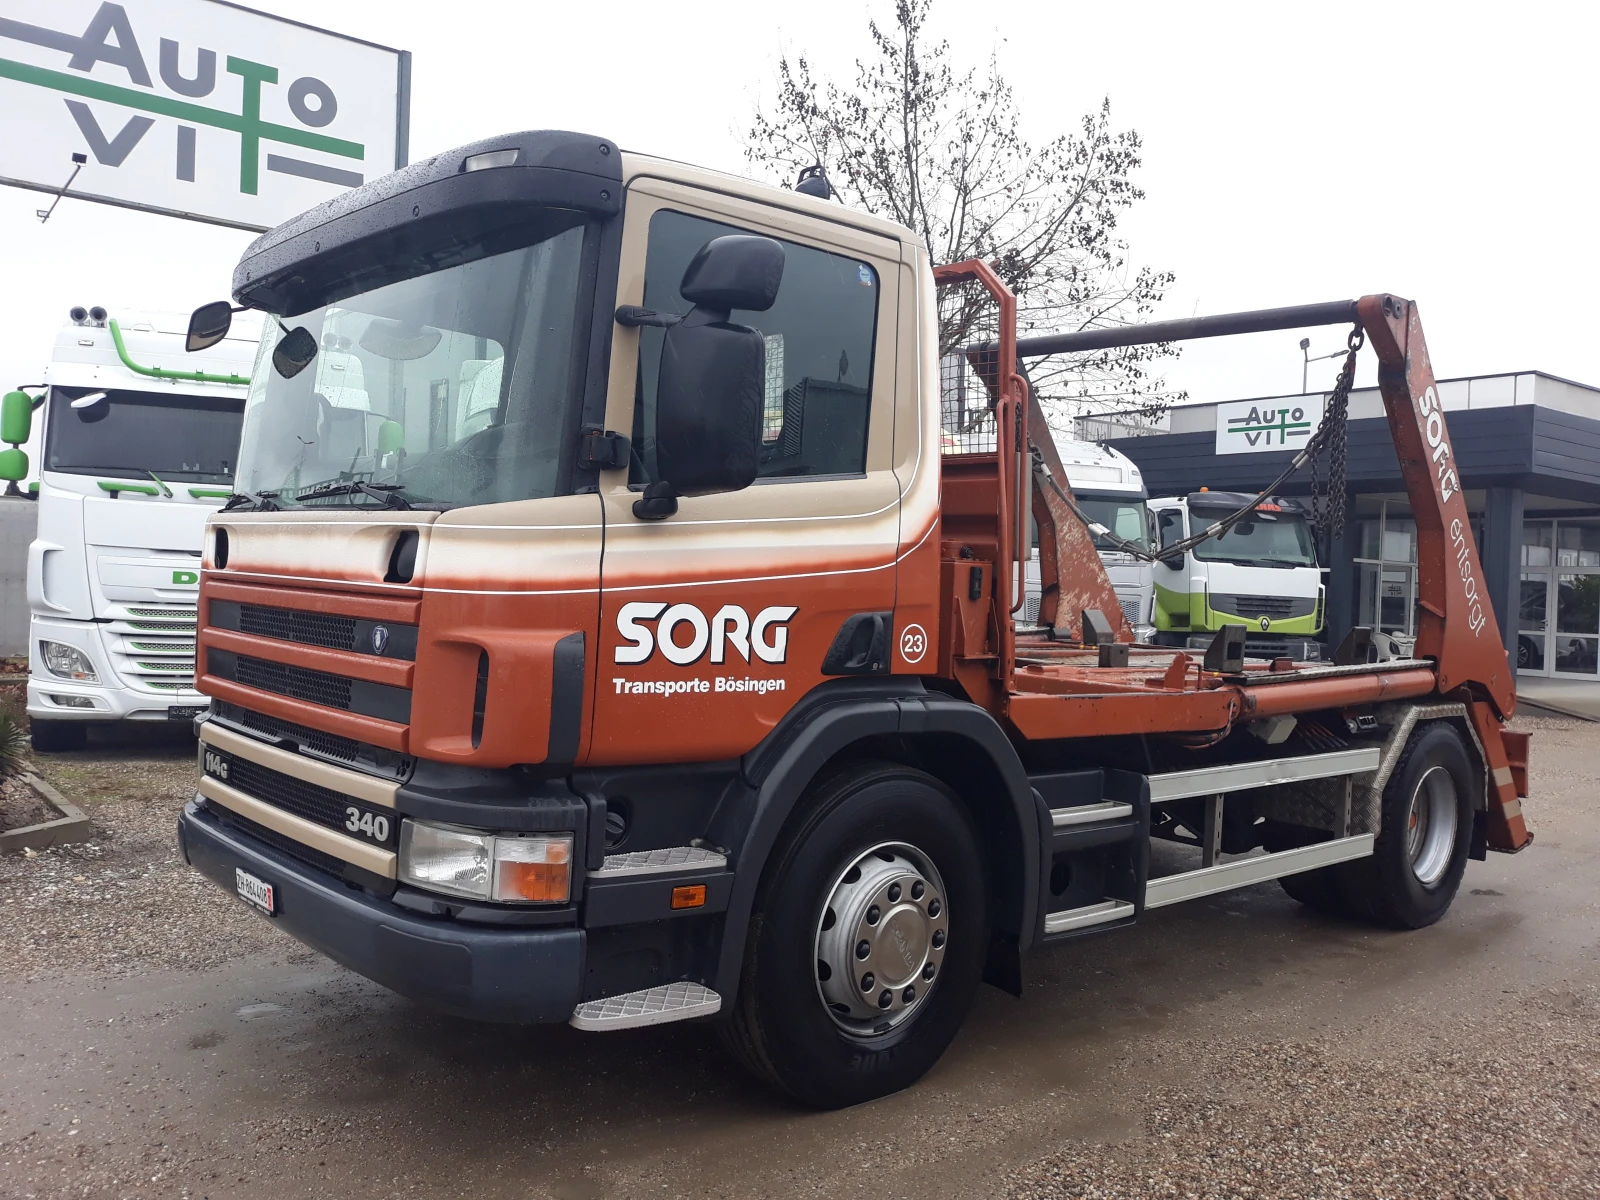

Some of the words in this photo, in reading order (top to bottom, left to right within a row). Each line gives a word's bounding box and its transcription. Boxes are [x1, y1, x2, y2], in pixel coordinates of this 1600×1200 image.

[1450, 518, 1486, 637] entsorgt
[614, 602, 799, 665] SORG
[903, 634, 923, 653] 23
[612, 677, 710, 697] Transporte
[714, 677, 786, 693] Bösingen
[345, 806, 389, 842] 340
